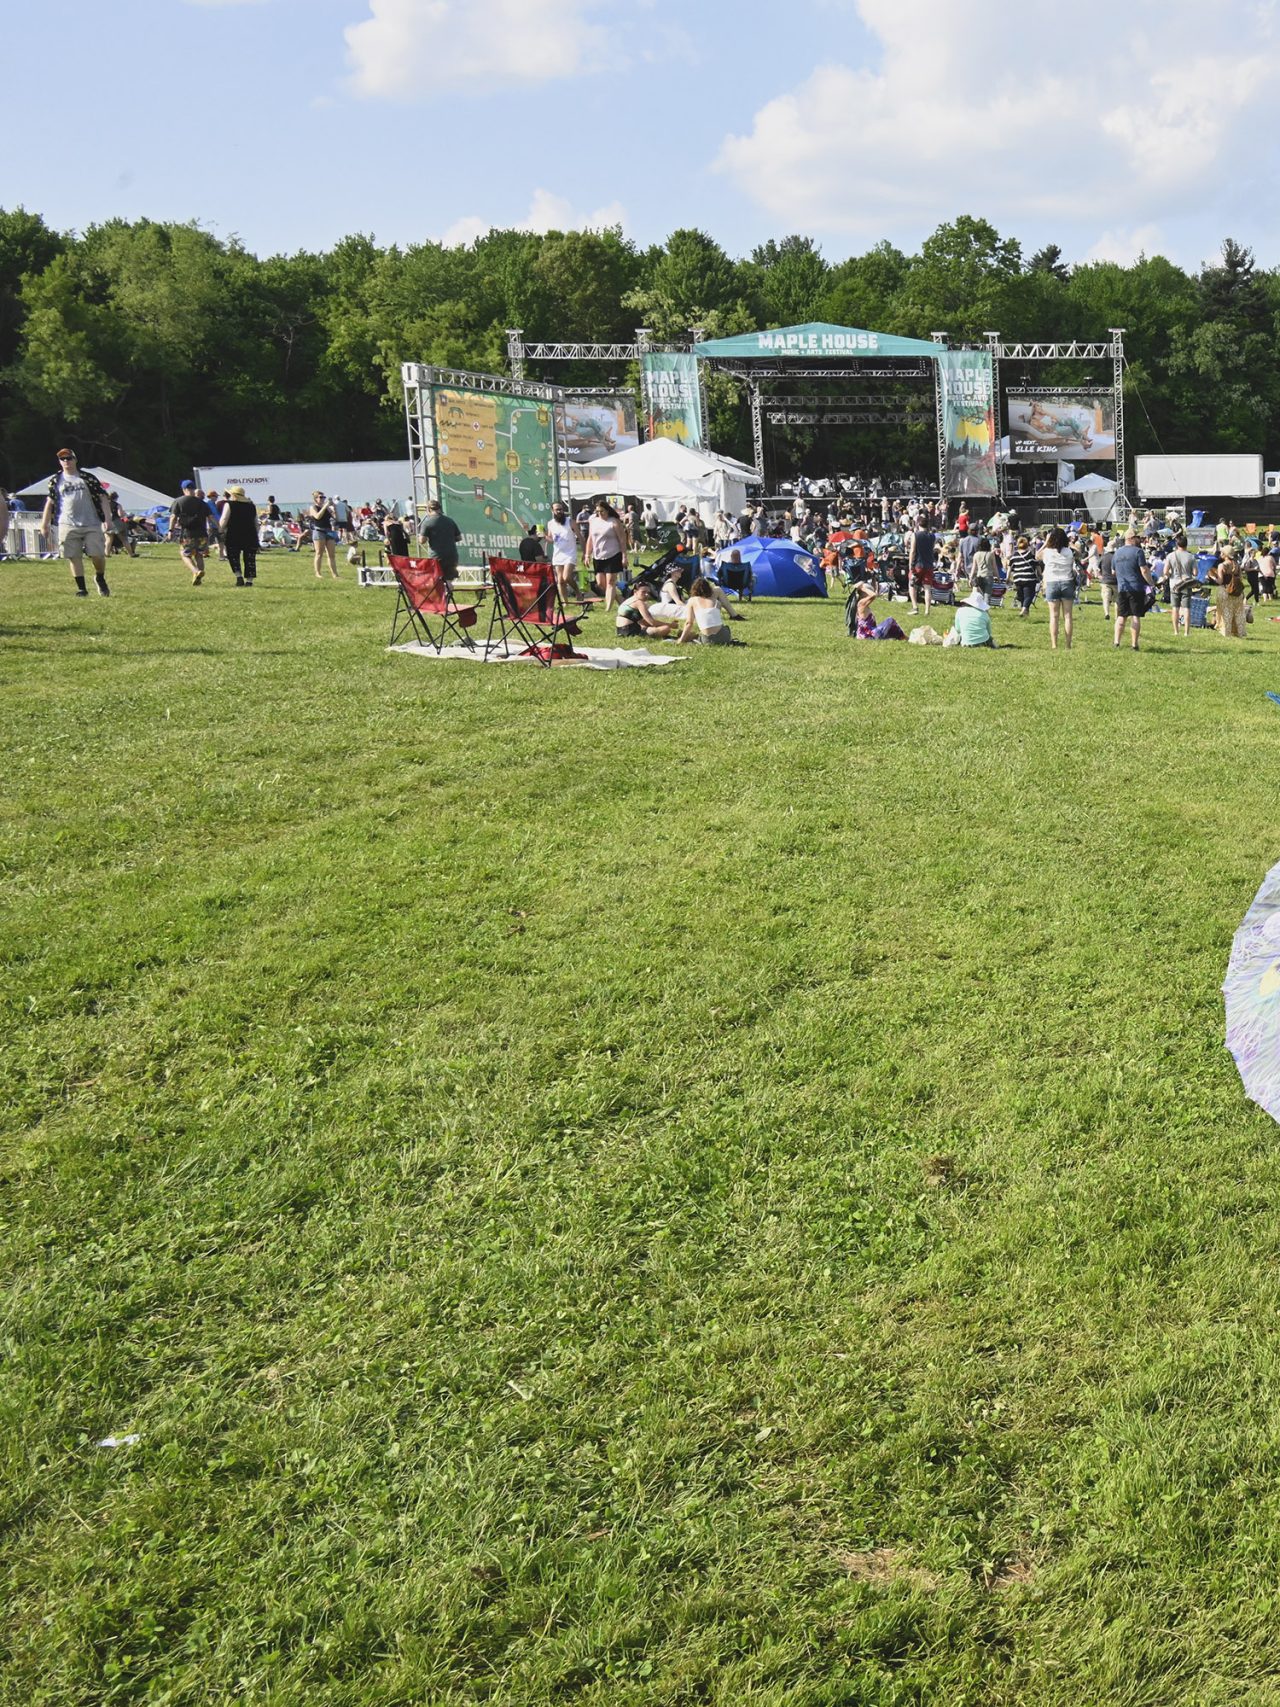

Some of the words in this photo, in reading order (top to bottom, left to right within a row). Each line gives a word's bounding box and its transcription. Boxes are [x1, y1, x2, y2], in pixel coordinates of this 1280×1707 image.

[758, 333, 818, 349] MAPLE
[822, 333, 878, 349] HOUSE
[646, 370, 694, 384] MAPLE
[944, 368, 990, 382] MAPLE
[944, 381, 991, 395] HOUSE
[455, 533, 486, 547] APLE
